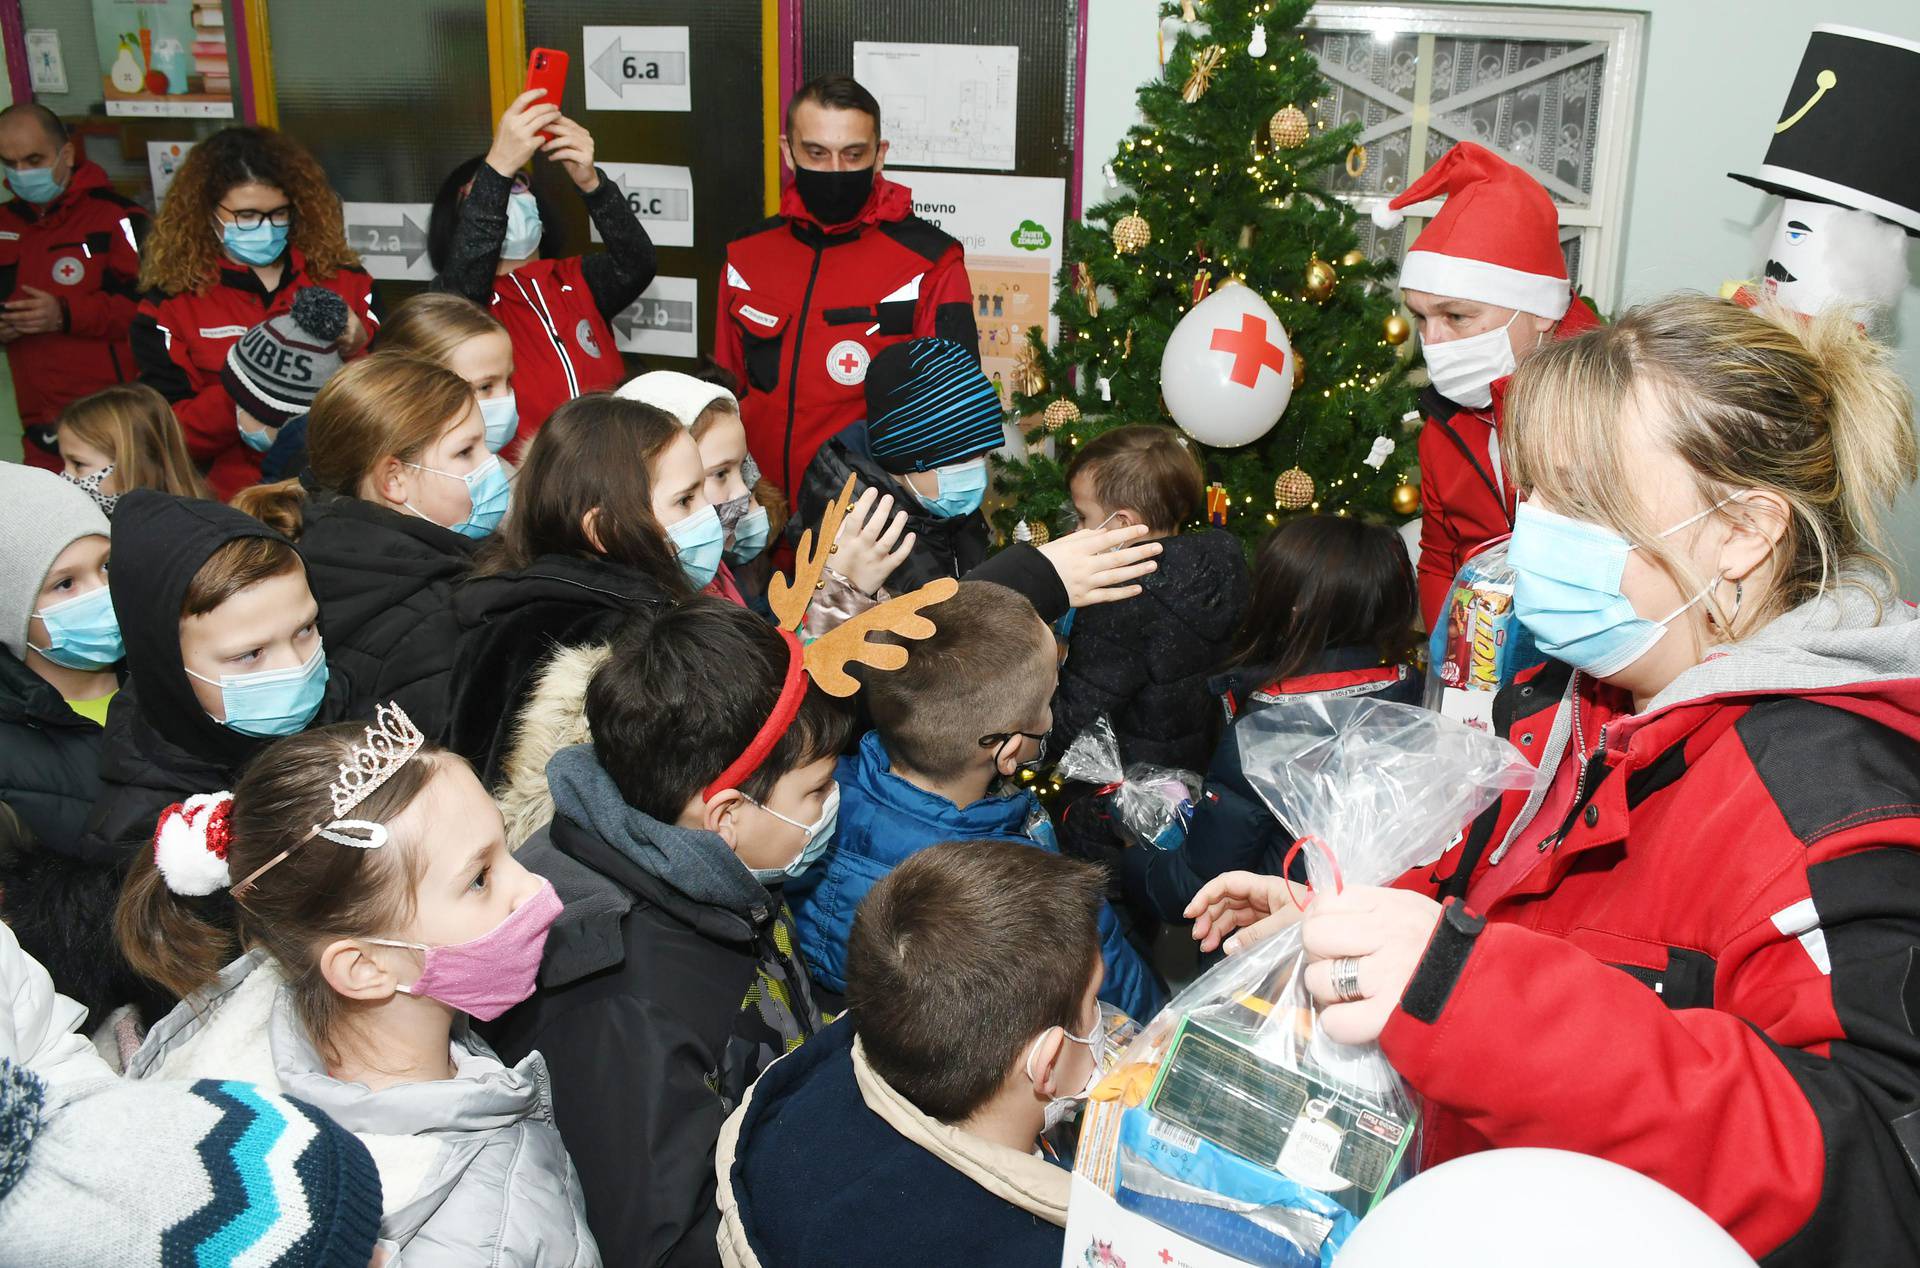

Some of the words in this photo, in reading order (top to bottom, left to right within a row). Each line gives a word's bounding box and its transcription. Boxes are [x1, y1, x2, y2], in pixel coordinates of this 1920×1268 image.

[622, 56, 659, 79] 6.a
[627, 192, 662, 214] 6.c
[368, 230, 400, 252] 2.a
[632, 303, 668, 326] 2.b
[242, 325, 313, 382] VIBES
[1472, 609, 1498, 684] LION
